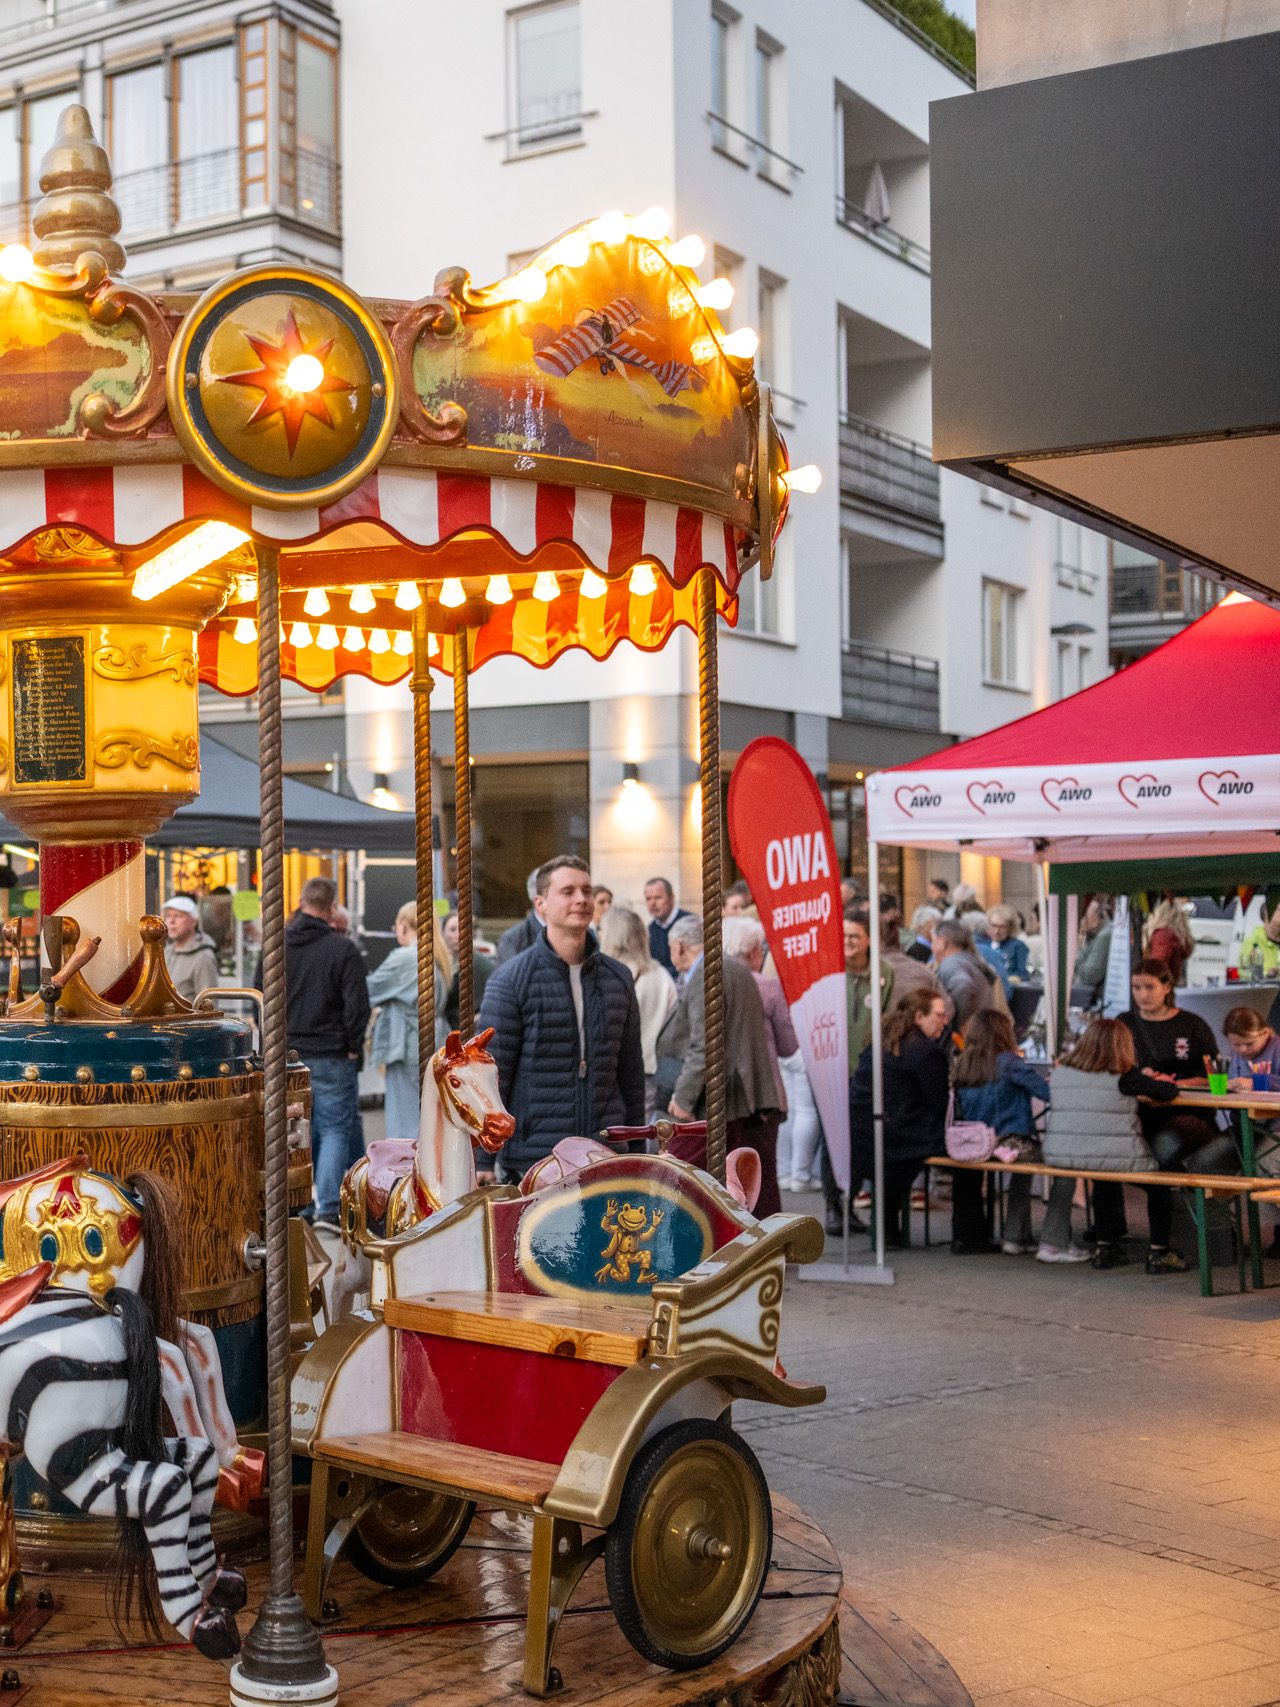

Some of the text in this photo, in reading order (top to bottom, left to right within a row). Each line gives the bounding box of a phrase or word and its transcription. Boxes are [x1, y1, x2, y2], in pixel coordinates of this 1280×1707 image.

[1136, 785, 1171, 798] AWO
[1217, 782, 1254, 794] AWO
[910, 795, 942, 808] AWO
[983, 792, 1016, 805] AWO
[1058, 789, 1092, 802] AWO
